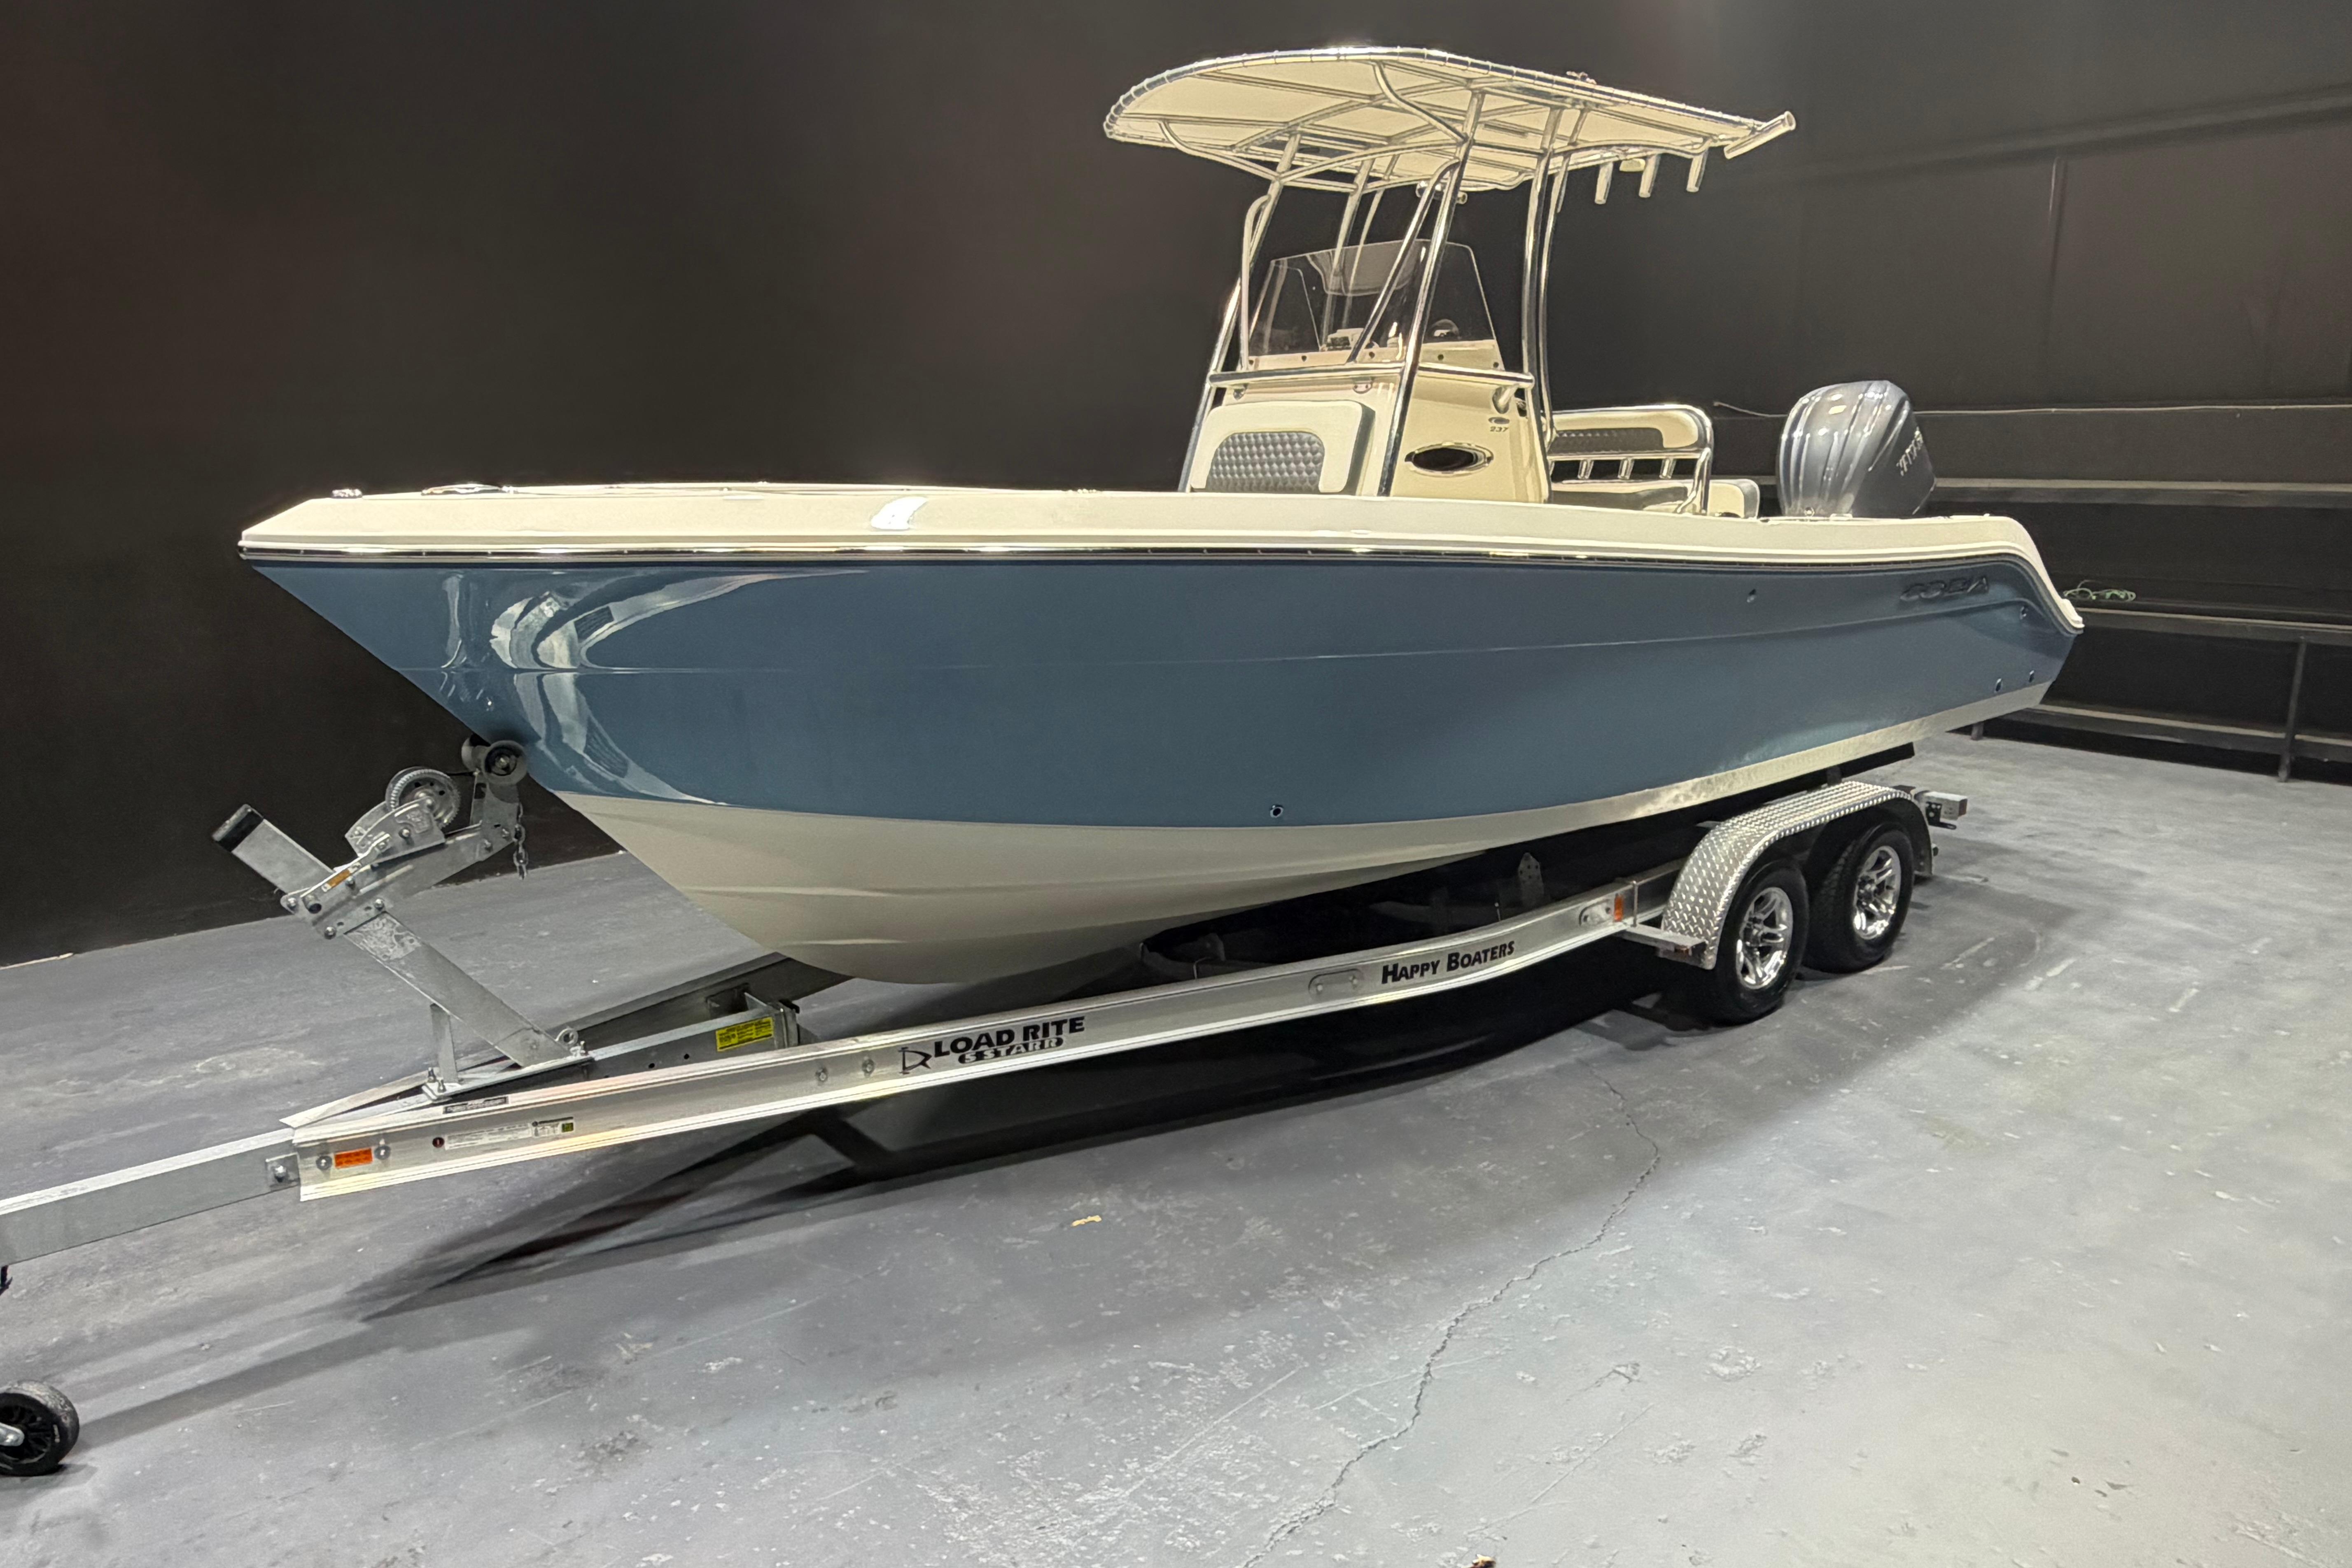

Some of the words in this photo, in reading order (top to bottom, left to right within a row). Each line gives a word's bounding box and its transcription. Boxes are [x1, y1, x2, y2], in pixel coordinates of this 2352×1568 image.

[1381, 960, 1440, 984] HAPPY
[1447, 941, 1515, 972] BOATERS
[934, 1029, 1015, 1057] LOAD
[1023, 1016, 1085, 1041] RITE
